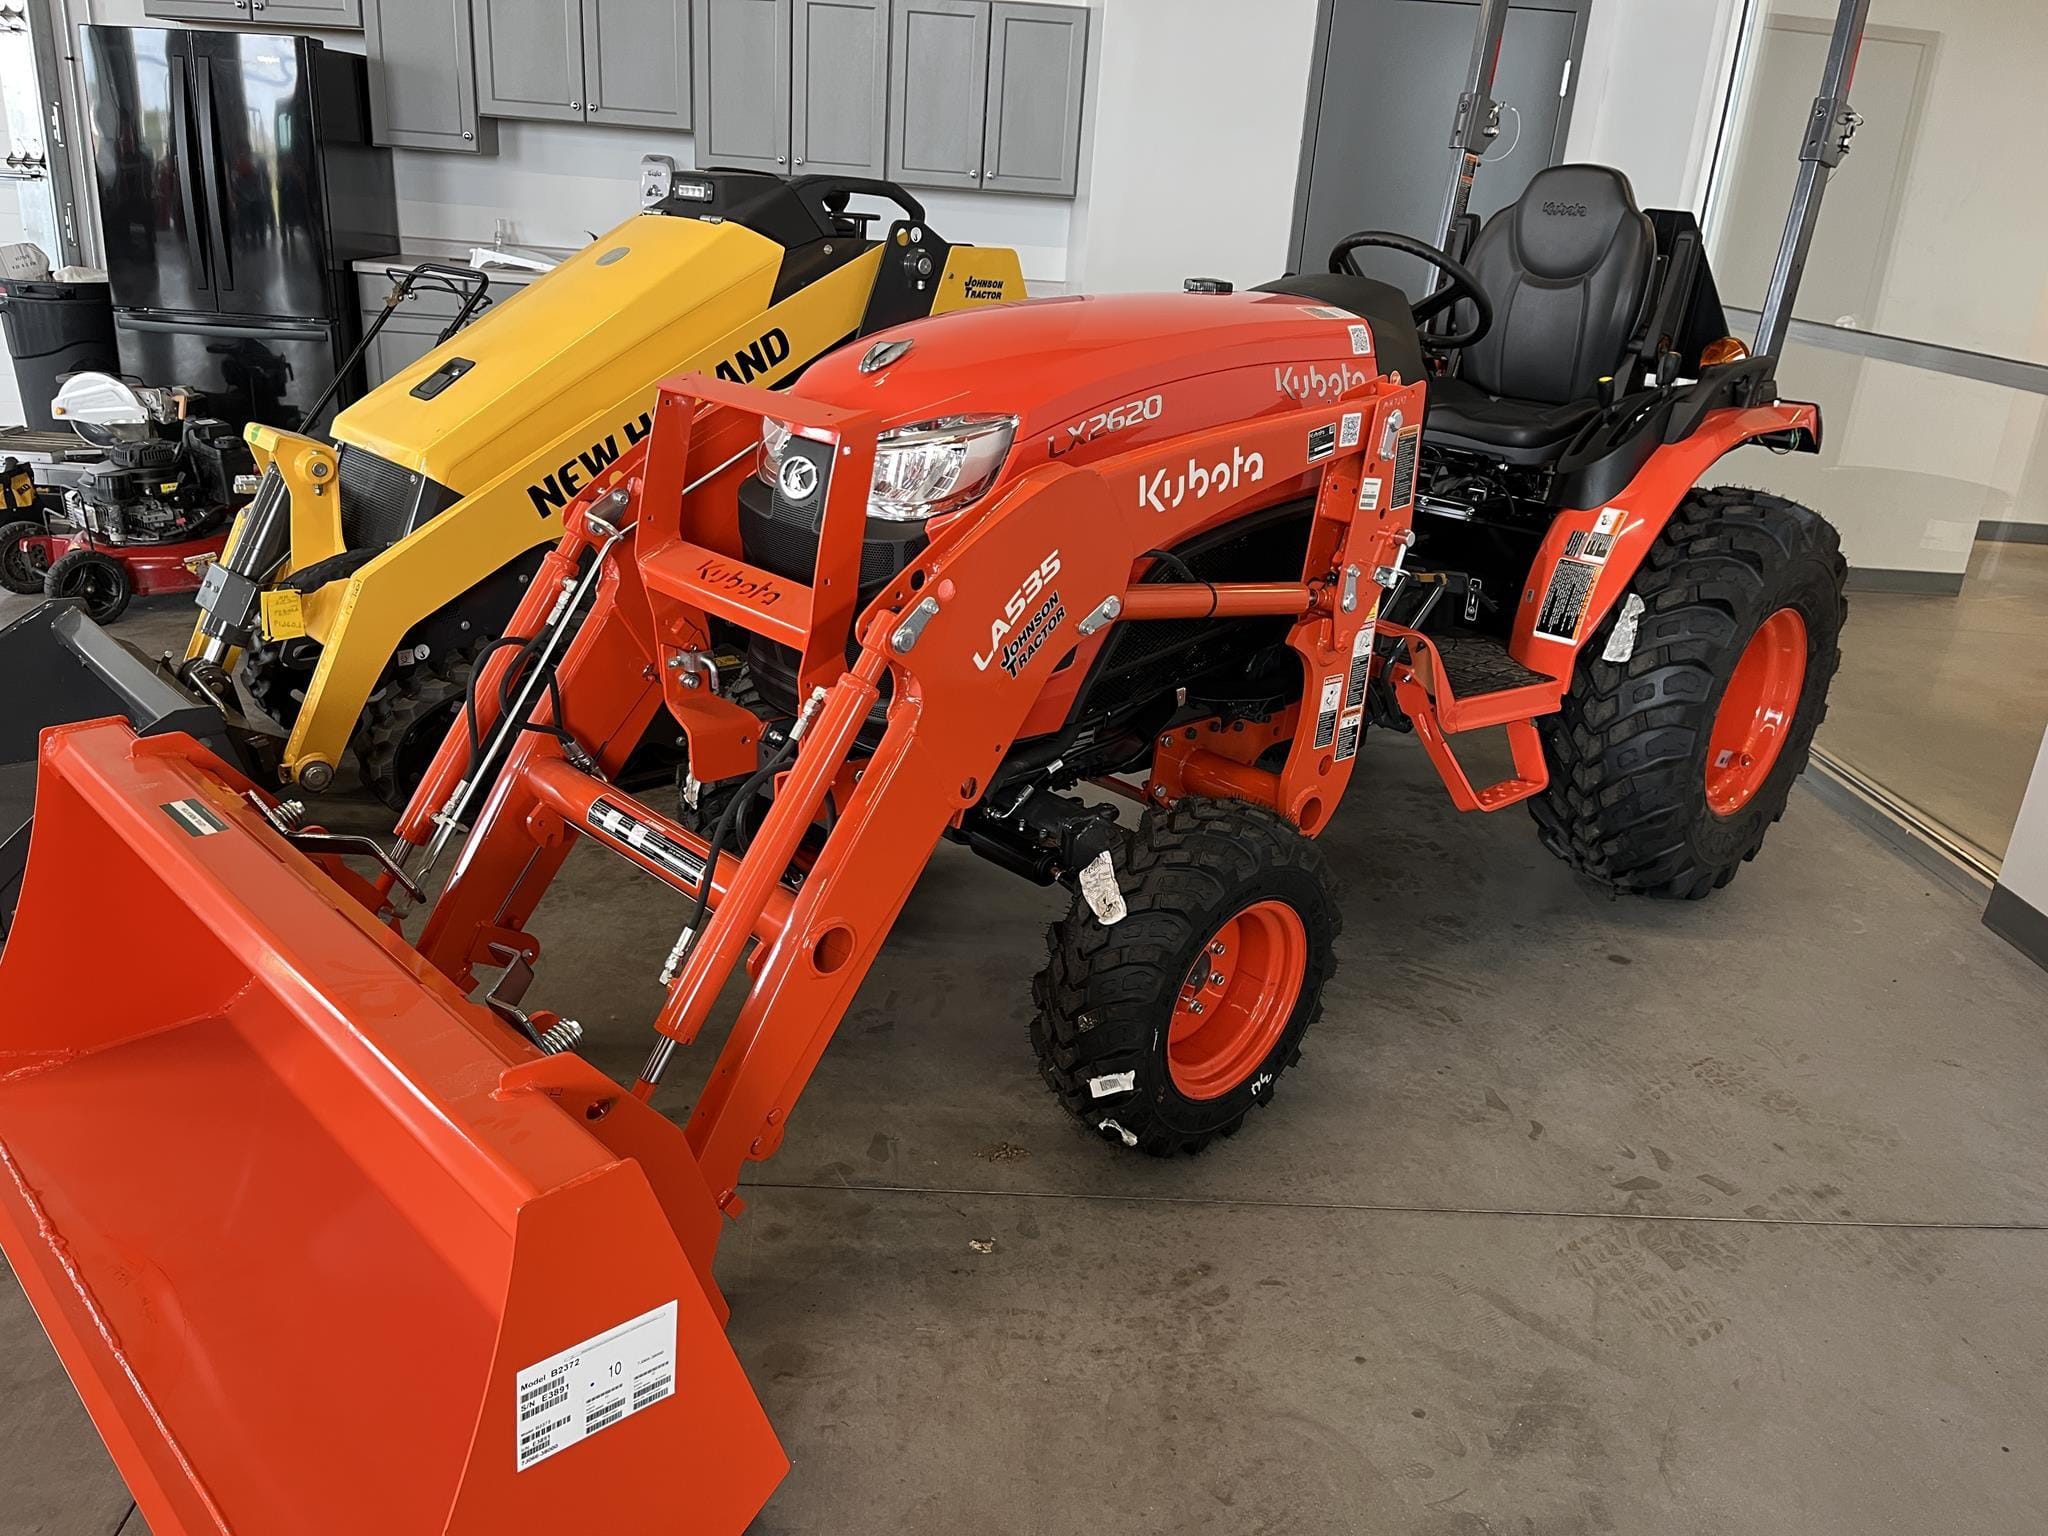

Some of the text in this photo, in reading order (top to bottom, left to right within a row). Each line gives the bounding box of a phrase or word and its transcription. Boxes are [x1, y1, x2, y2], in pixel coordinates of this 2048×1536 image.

[1047, 394, 1163, 459] LX2620
[526, 434, 621, 520] NEW
[1138, 445, 1265, 513] Kubota
[695, 559, 781, 606] Kubota
[972, 548, 1062, 672] LA535
[1000, 591, 1060, 669] JOHNSON
[1005, 606, 1066, 679] TRACTOR
[520, 1358, 580, 1392] Model B2372
[520, 1383, 570, 1412] S/N E3891
[608, 1361, 622, 1377] 10
